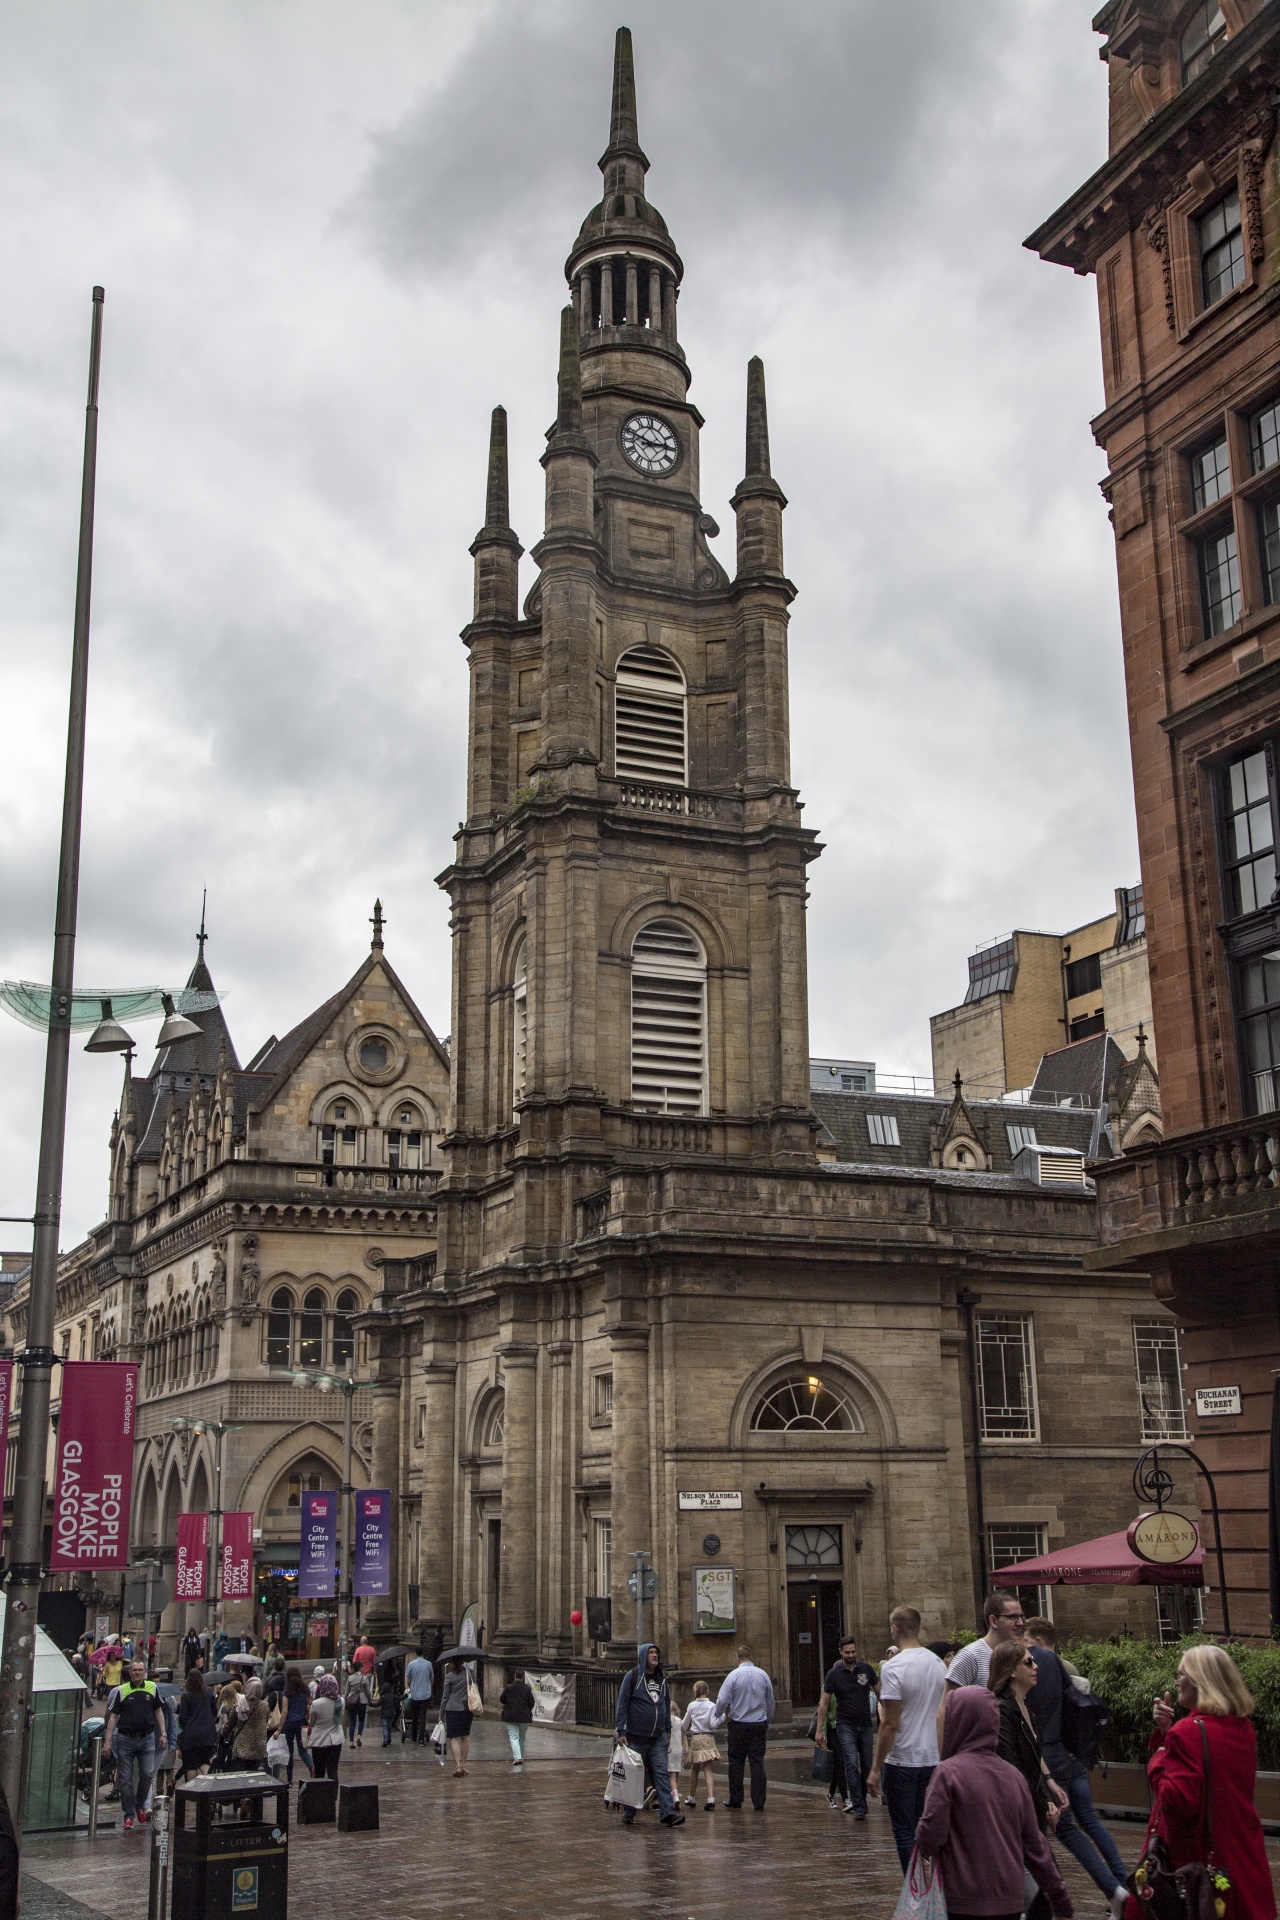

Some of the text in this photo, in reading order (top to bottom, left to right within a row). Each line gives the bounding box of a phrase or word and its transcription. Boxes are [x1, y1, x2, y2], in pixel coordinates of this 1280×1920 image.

[124, 1373, 134, 1434] Let's Celebrate
[1197, 1390, 1237, 1400] BUCHANAN
[1204, 1400, 1232, 1408] STREET
[57, 1440, 82, 1558] GLASGOW
[78, 1492, 100, 1558] MAKE
[99, 1474, 122, 1558] PEOPLE
[366, 1524, 379, 1532] City
[1137, 1532, 1196, 1543] AMARONE
[177, 1547, 186, 1596] GLASGOW
[185, 1568, 193, 1596] MAKE
[193, 1560, 202, 1596] PEOPLE
[224, 1546, 232, 1594] GLASGOW
[232, 1567, 240, 1594] MAKE
[240, 1559, 248, 1593] PEOPLE
[708, 1572, 732, 1582] SGT
[1040, 1568, 1082, 1577] AMARONE
[230, 1837, 261, 1846] LITTER
